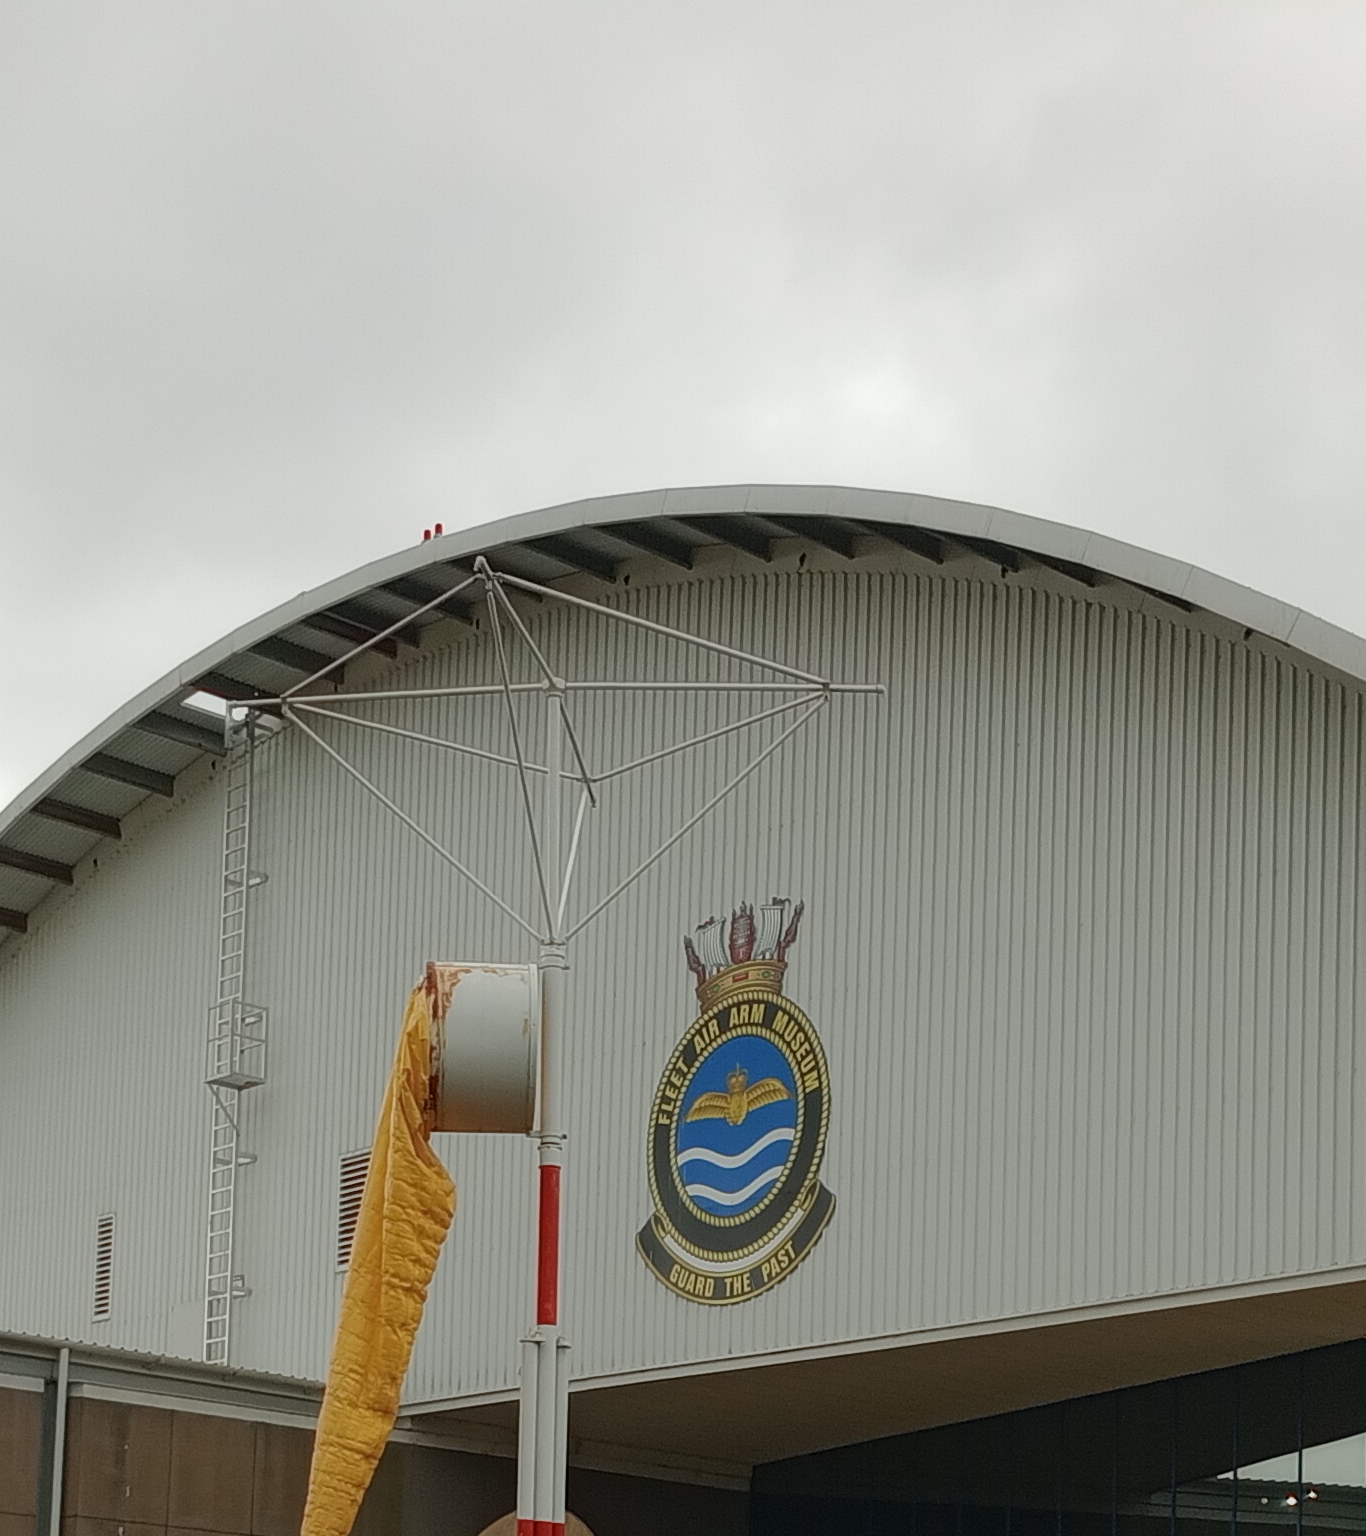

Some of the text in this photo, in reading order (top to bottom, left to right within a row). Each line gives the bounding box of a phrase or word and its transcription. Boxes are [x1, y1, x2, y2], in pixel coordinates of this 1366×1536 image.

[658, 1003, 820, 1125] FLEET AIR ARM MUSEUM
[669, 1240, 797, 1298] GUARD THE PAST
